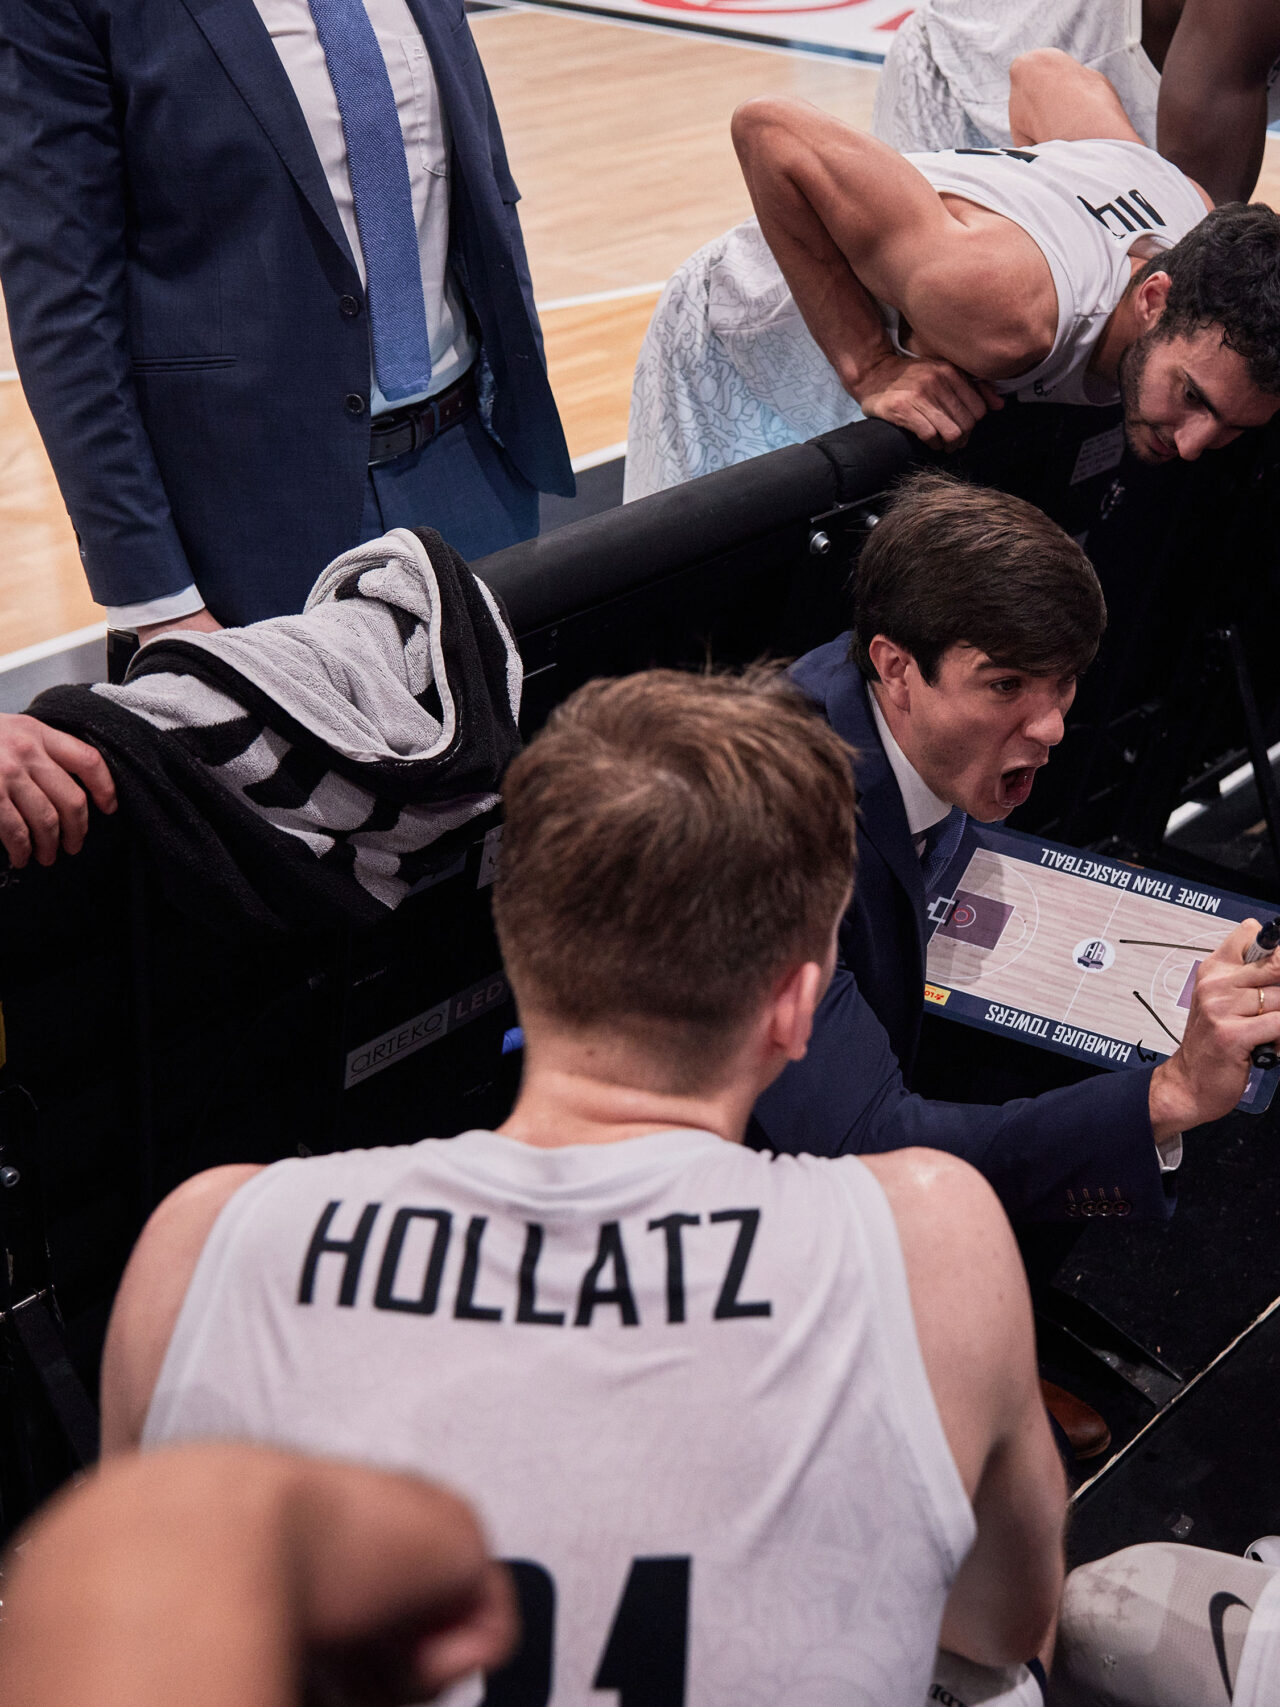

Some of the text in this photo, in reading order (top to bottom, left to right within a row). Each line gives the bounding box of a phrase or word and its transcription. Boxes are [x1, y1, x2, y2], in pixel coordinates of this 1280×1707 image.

[1040, 847, 1222, 914] MORE THAN BASKETBALL
[455, 979, 505, 1020] LED
[984, 1003, 1052, 1039] TOWERS
[1051, 1023, 1133, 1063] HAMBURG
[297, 1199, 774, 1327] HOLLATZ
